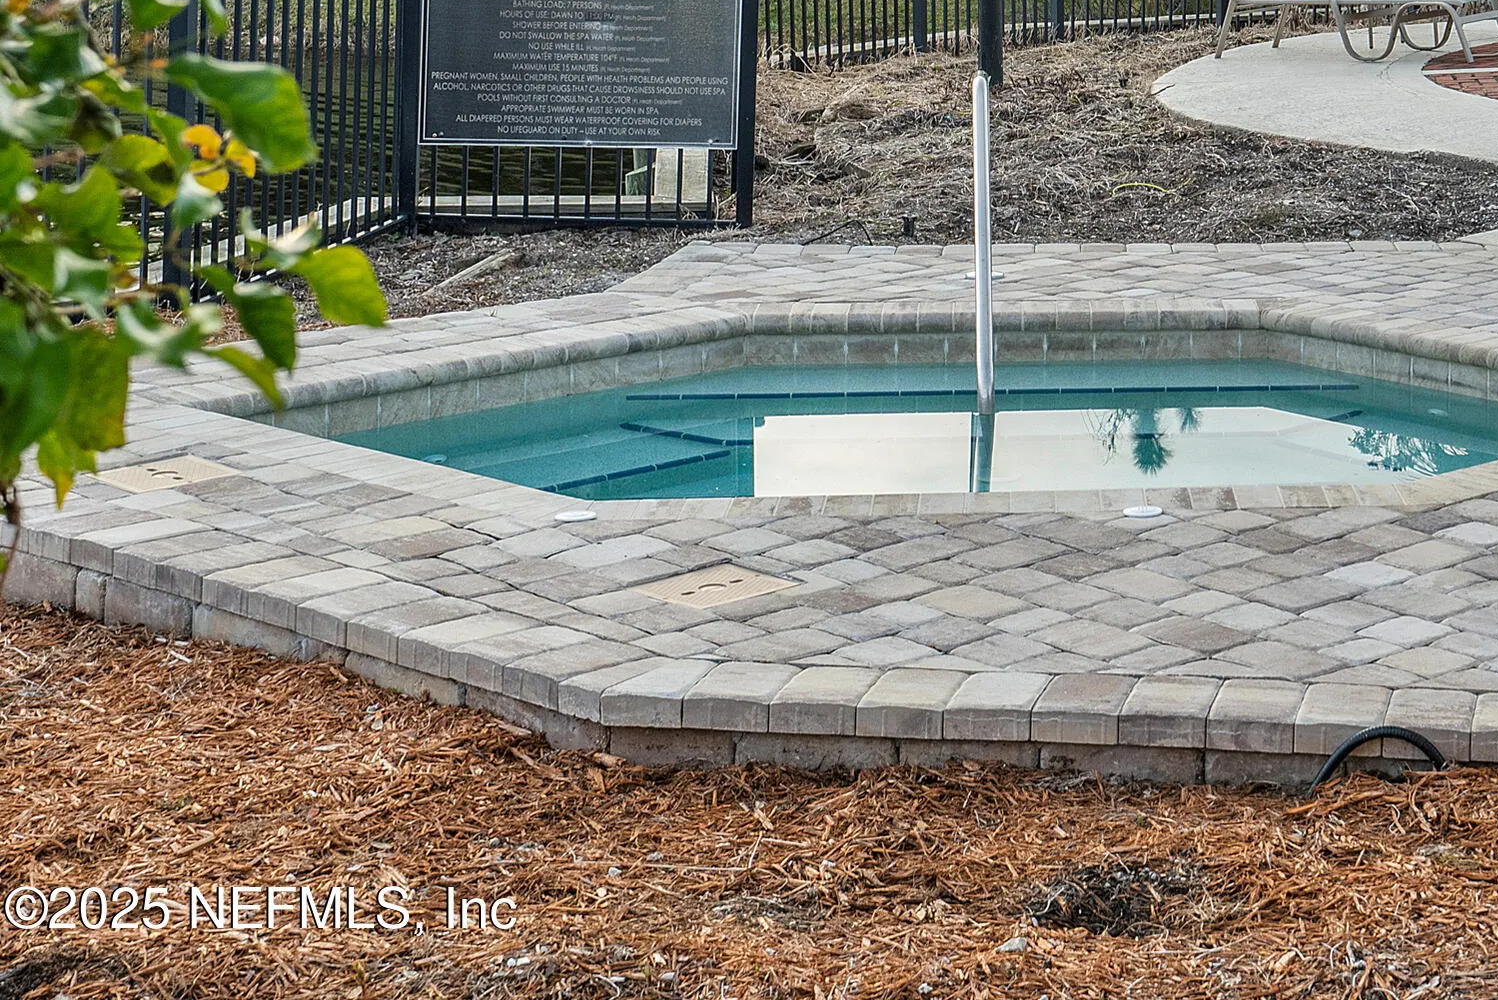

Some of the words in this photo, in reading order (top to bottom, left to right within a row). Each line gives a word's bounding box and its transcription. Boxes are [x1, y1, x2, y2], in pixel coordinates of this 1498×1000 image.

[512, 0, 543, 8] BATHING
[572, 1, 602, 9] PERSONS
[512, 21, 541, 29] SHOWER
[542, 21, 568, 29] BEFORE
[499, 31, 511, 39] DO
[512, 31, 527, 39] NOT
[528, 32, 562, 40] SWALLOW
[563, 32, 575, 40] THE
[576, 32, 590, 40] SPA
[590, 33, 614, 41] WATER
[528, 42, 540, 50] NO
[541, 42, 553, 50] USE
[575, 43, 584, 51] ILL
[493, 52, 528, 60] MAXIMUM
[529, 52, 553, 60] WATER
[553, 53, 599, 61] TEMPERATURE
[512, 63, 547, 71] MAXIMUM
[548, 64, 560, 72] USE
[562, 64, 569, 72] 15
[570, 64, 599, 72] MINUTES
[431, 71, 468, 80] PREGNANT
[500, 73, 522, 81] SMALL
[560, 74, 585, 83] PEOPLE
[586, 74, 602, 83] WITH
[603, 75, 628, 83] HEALTH
[629, 75, 664, 84] PROBLEMS
[665, 76, 681, 85] AND
[682, 76, 707, 85] PEOPLE
[707, 77, 728, 86] USING
[471, 83, 511, 92] NARCOTICS
[511, 84, 523, 92] OR
[523, 84, 545, 92] OTHER
[546, 84, 571, 93] DRUGS
[572, 85, 588, 93] THAT
[589, 85, 612, 94] CAUSE
[612, 85, 655, 94] DROWSINESS
[656, 86, 683, 95] SHOULD
[684, 87, 699, 95] NOT
[700, 87, 712, 95] USE
[713, 87, 725, 96] SPA
[476, 93, 500, 102] POOLS
[502, 94, 532, 102] WITHOUT
[532, 94, 549, 103] FIRST
[549, 95, 593, 103] CONSULTING
[602, 95, 631, 104] DOCTOR
[501, 104, 545, 113] APPROPRIATE
[546, 105, 585, 114] SWIMWEAR
[586, 106, 604, 114] MUST
[605, 106, 613, 114] BE
[614, 106, 636, 114] WORN
[637, 106, 644, 115] IN
[646, 107, 659, 115] SPA
[456, 114, 468, 122] ALL
[469, 114, 502, 123] DIAPERED
[503, 115, 534, 124] PERSONS
[535, 115, 553, 124] MUST
[554, 116, 574, 124] WEAR
[575, 116, 620, 125] WATERPROOF
[621, 117, 659, 126] COVERING
[660, 118, 674, 126] FOR
[675, 118, 702, 127] DIAPERS
[497, 126, 509, 134] NO
[510, 126, 547, 134] LIFEGUARD
[548, 126, 560, 134] ON
[561, 126, 578, 135] DUTY
[585, 127, 597, 135] USE
[598, 127, 607, 135] AT
[607, 127, 627, 135] YOUR
[628, 127, 646, 135] OWN
[647, 127, 660, 136] RISK
